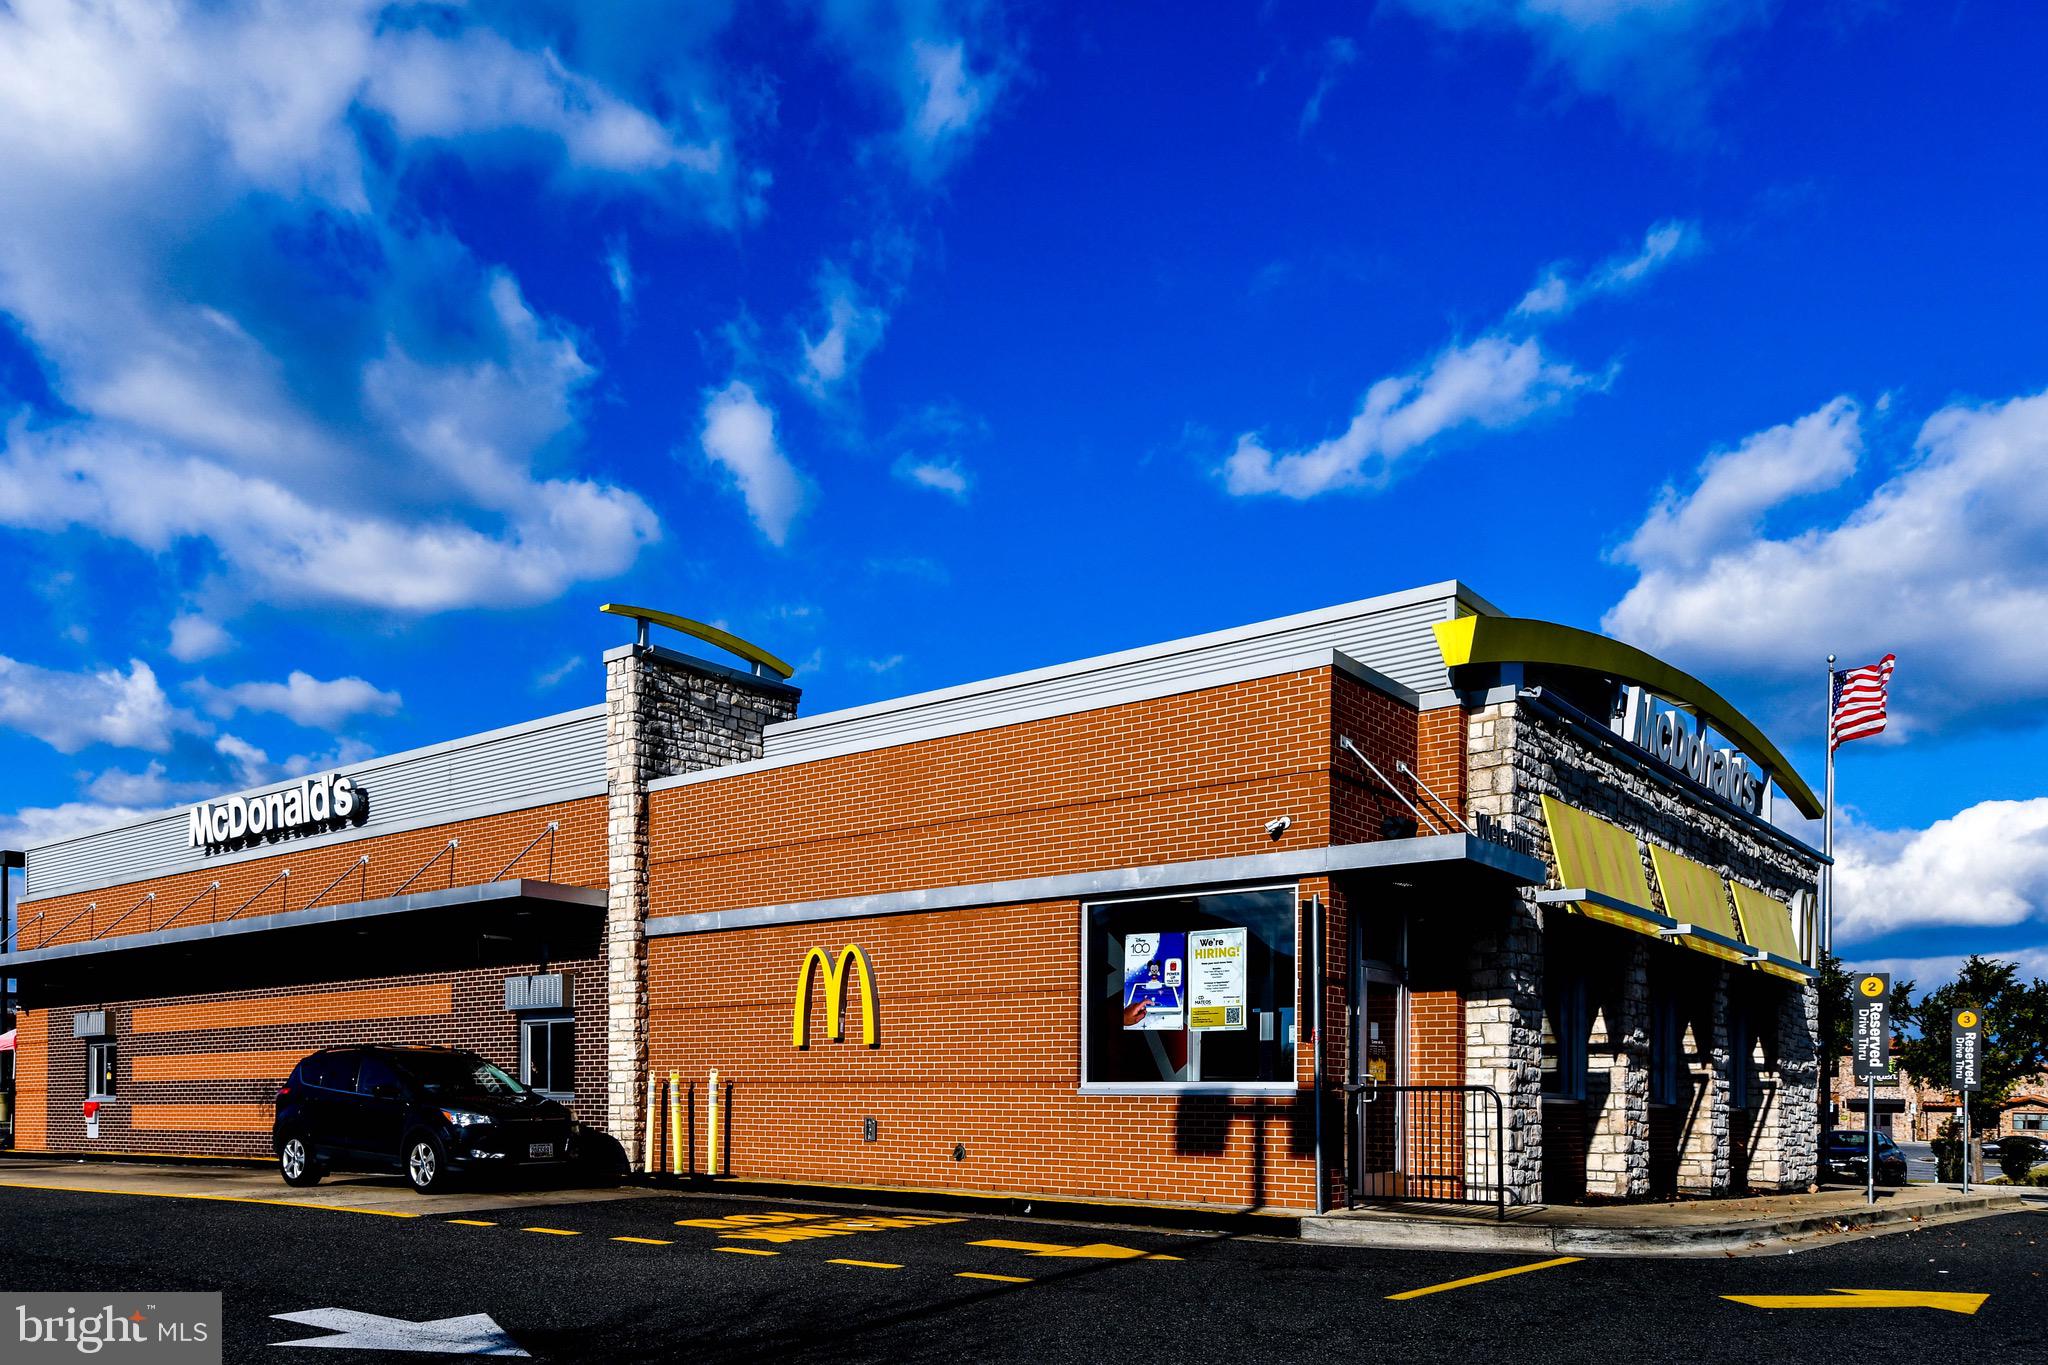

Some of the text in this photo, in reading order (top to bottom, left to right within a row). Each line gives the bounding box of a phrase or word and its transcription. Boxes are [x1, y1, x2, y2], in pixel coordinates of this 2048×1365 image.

[1623, 686, 1757, 815] McDonald's
[188, 773, 357, 847] McDonald's
[1131, 943, 1151, 954] 100
[1195, 946, 1240, 959] HIRING!
[1200, 938, 1224, 947] We're
[1868, 982, 1877, 991] 2
[1858, 1009, 1869, 1061] Drive Thru
[1869, 1002, 1884, 1068] Reserved
[1963, 1016, 1971, 1024] 3
[1955, 1037, 1965, 1079] Drive Thru
[1964, 1032, 1977, 1085] Reserved
